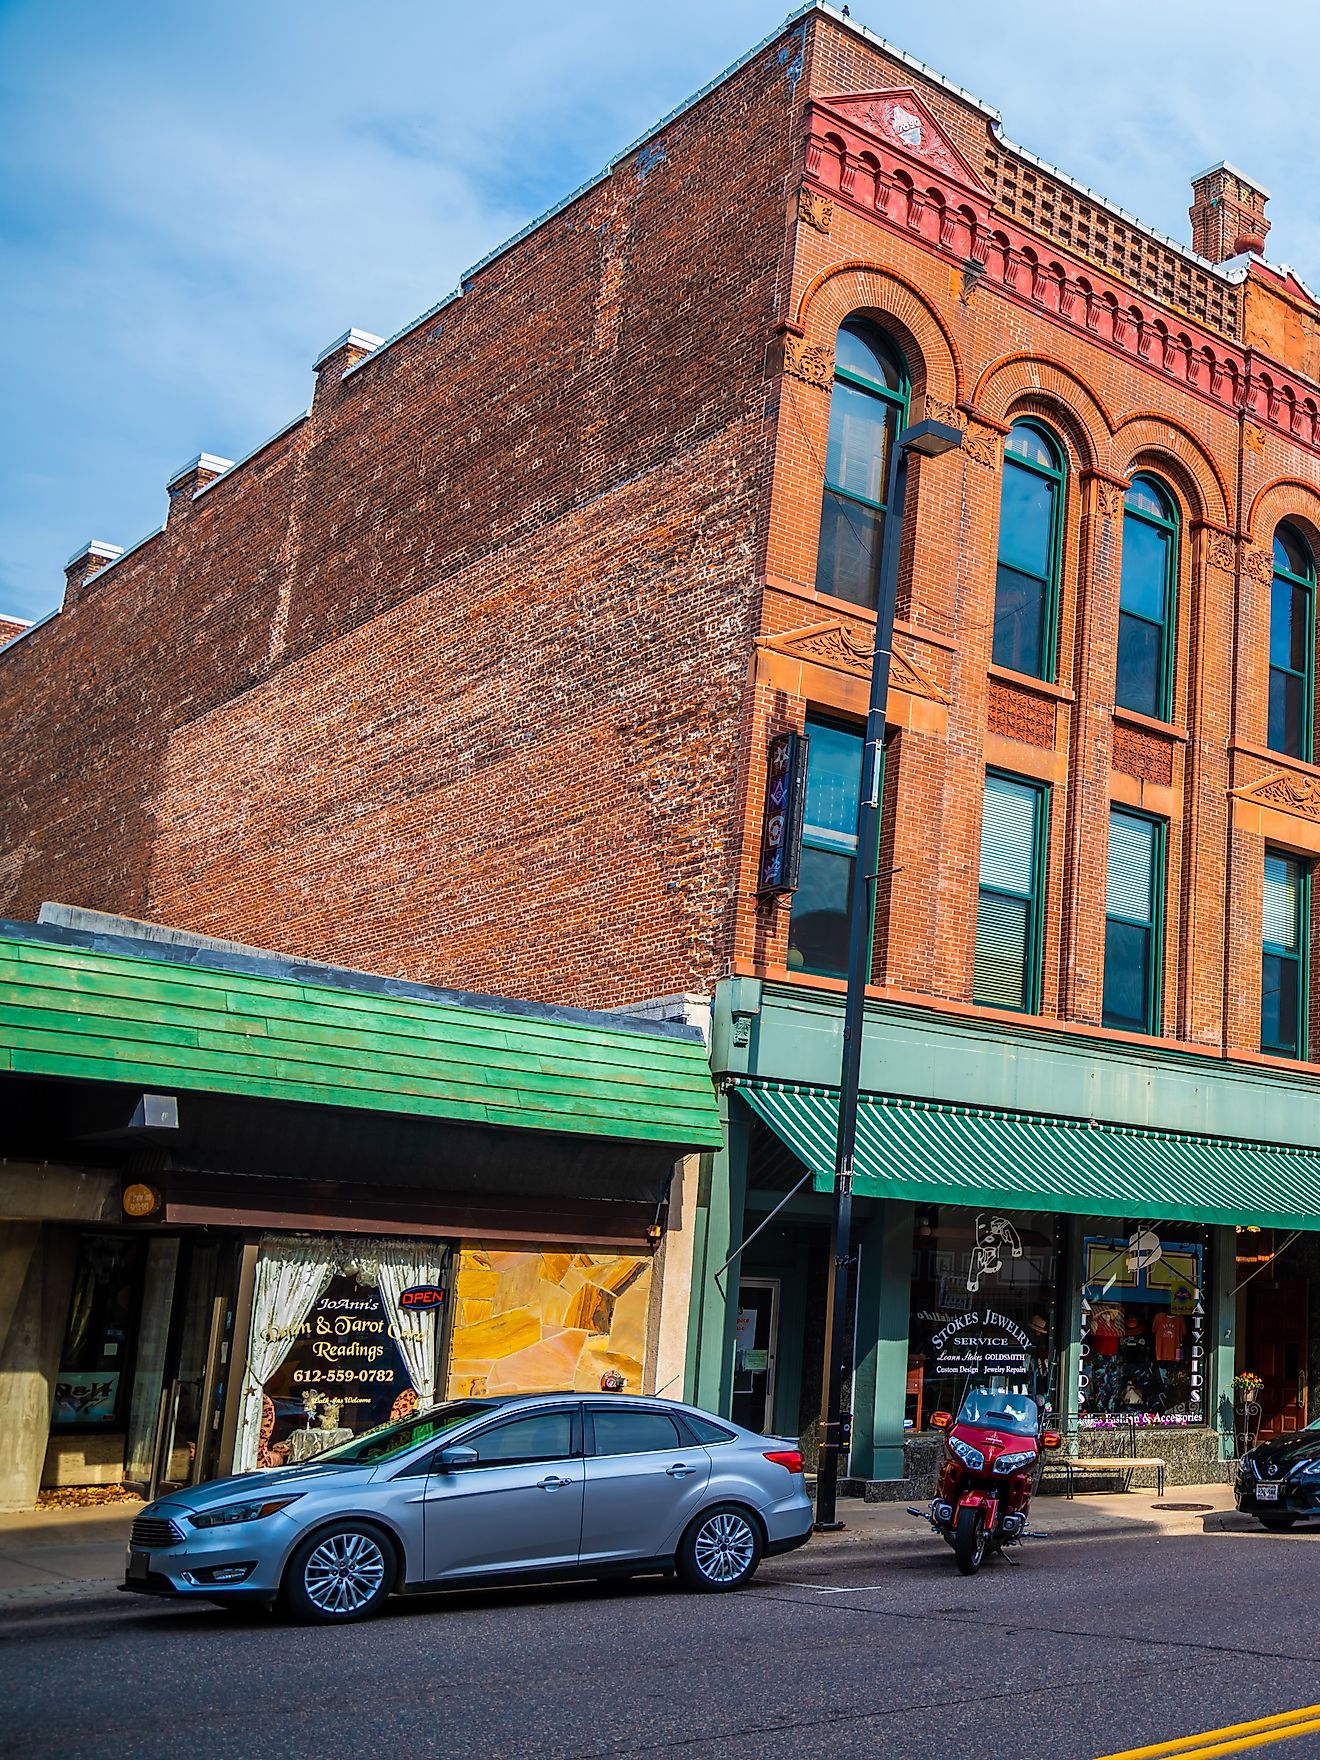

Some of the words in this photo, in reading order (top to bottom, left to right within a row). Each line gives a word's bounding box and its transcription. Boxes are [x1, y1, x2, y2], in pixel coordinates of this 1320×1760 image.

[402, 1291, 444, 1304] OPEN
[317, 1298, 379, 1311] JoAnn's
[316, 1315, 333, 1335] &
[334, 1316, 384, 1335] Tarot
[931, 1311, 980, 1350] STOKES
[982, 1308, 1033, 1350] JEWELRY
[953, 1337, 1009, 1346] SERVICE
[312, 1341, 384, 1362] Readings
[984, 1353, 1026, 1361] GOLDSMITH
[293, 1369, 394, 1383] 612-559-0782
[959, 1366, 979, 1375] Design
[983, 1366, 1006, 1375] Jewelry
[1006, 1366, 1027, 1375] Repairs
[344, 1396, 372, 1405] Welcome
[1142, 1412, 1151, 1424] &
